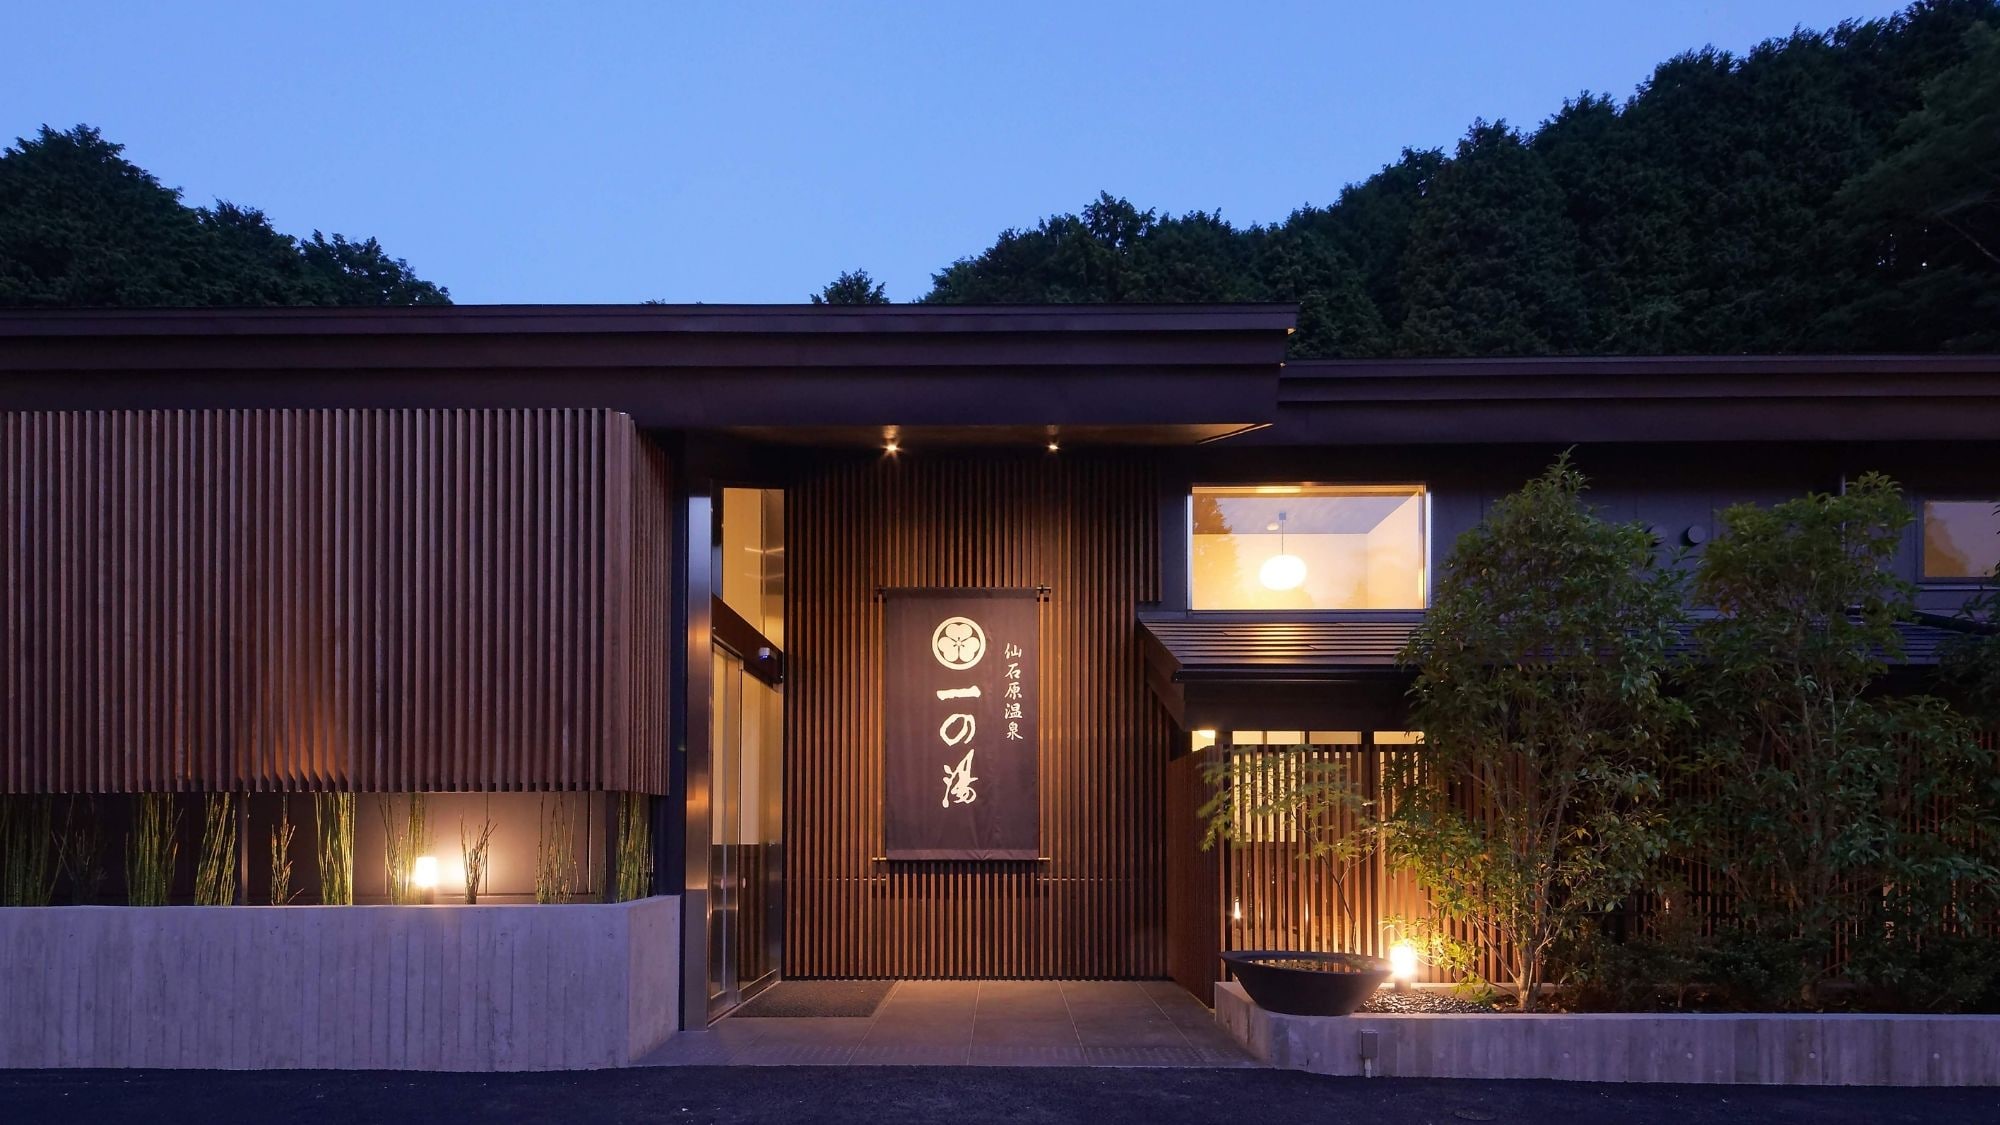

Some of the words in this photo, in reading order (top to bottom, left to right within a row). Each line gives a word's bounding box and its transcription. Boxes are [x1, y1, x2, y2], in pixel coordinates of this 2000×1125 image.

[936, 685, 982, 808] 一の湯
[1004, 642, 1023, 741] 仙石原温泉
